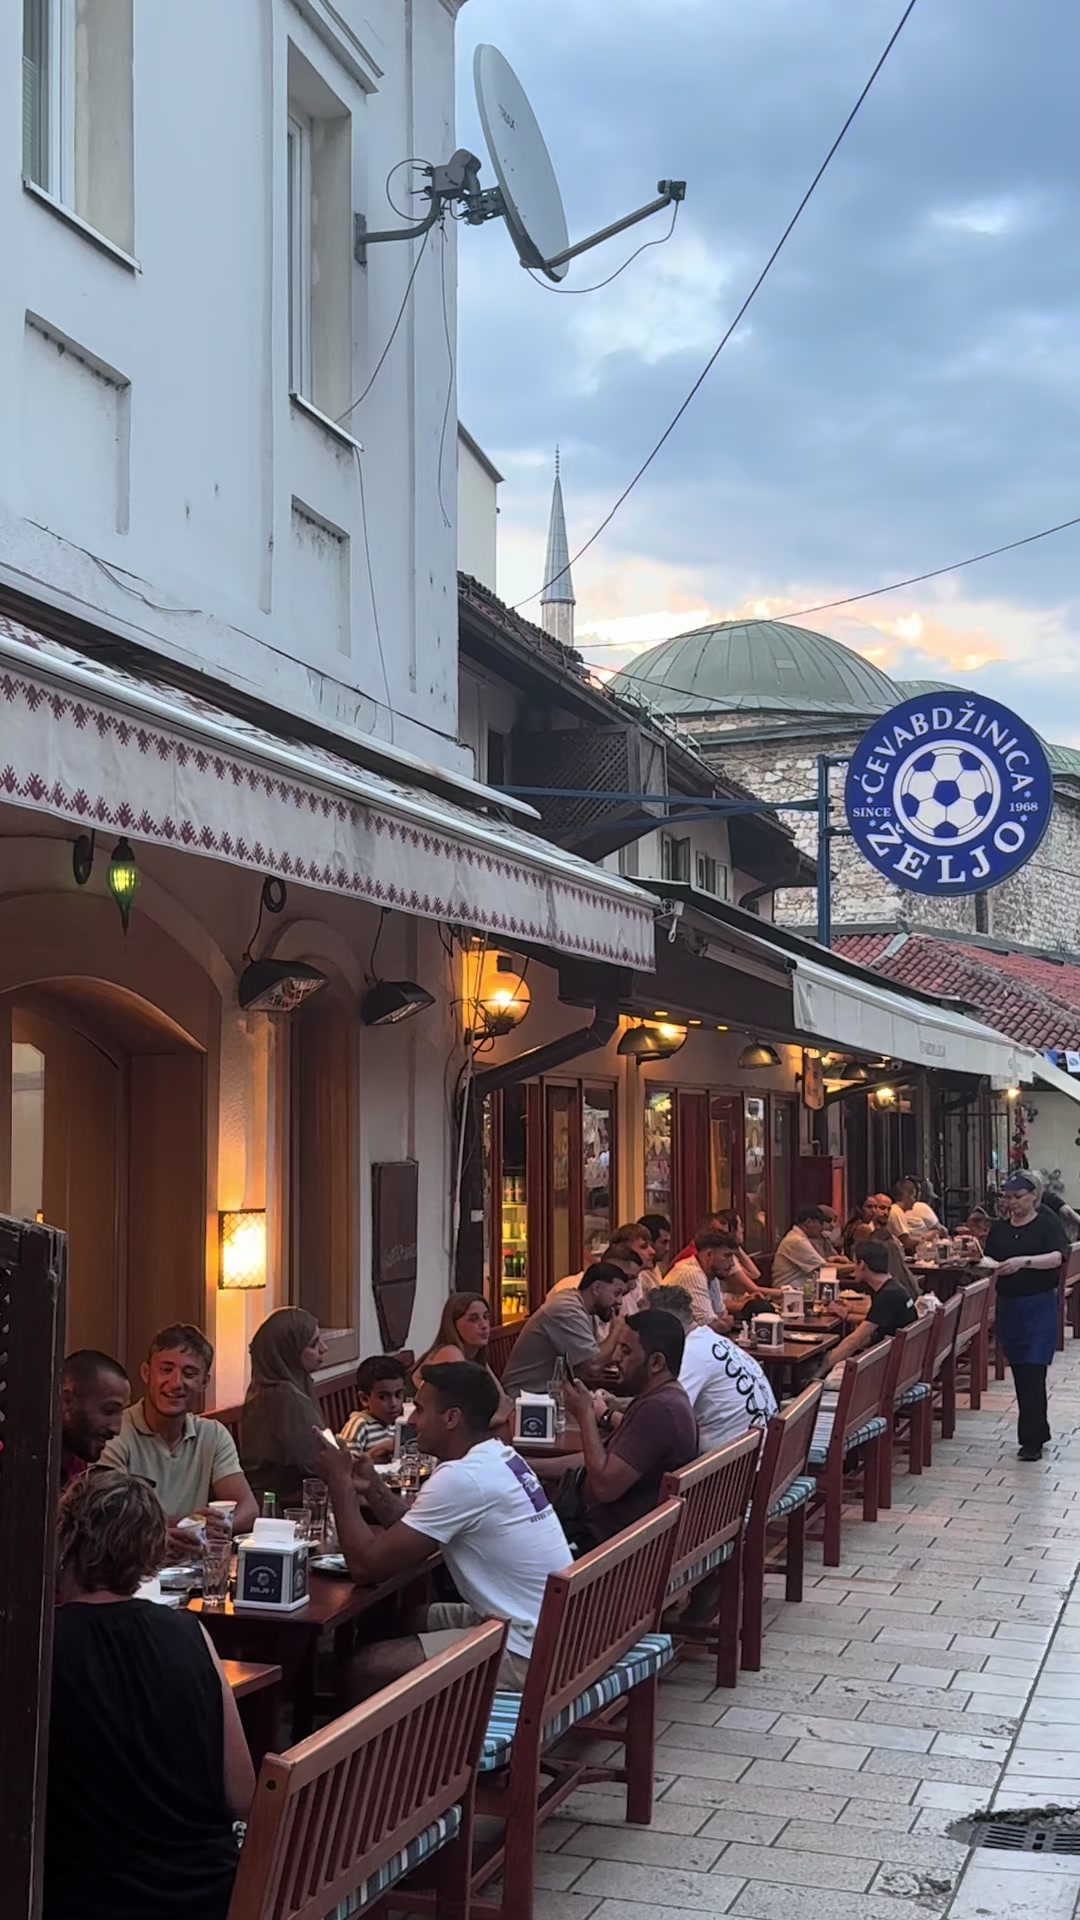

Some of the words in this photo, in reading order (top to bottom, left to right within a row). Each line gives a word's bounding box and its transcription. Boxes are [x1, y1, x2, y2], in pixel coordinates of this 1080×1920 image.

[852, 806, 892, 818] SINCE
[1008, 801, 1039, 813] 1968
[865, 820, 1026, 884] ŽELJO
